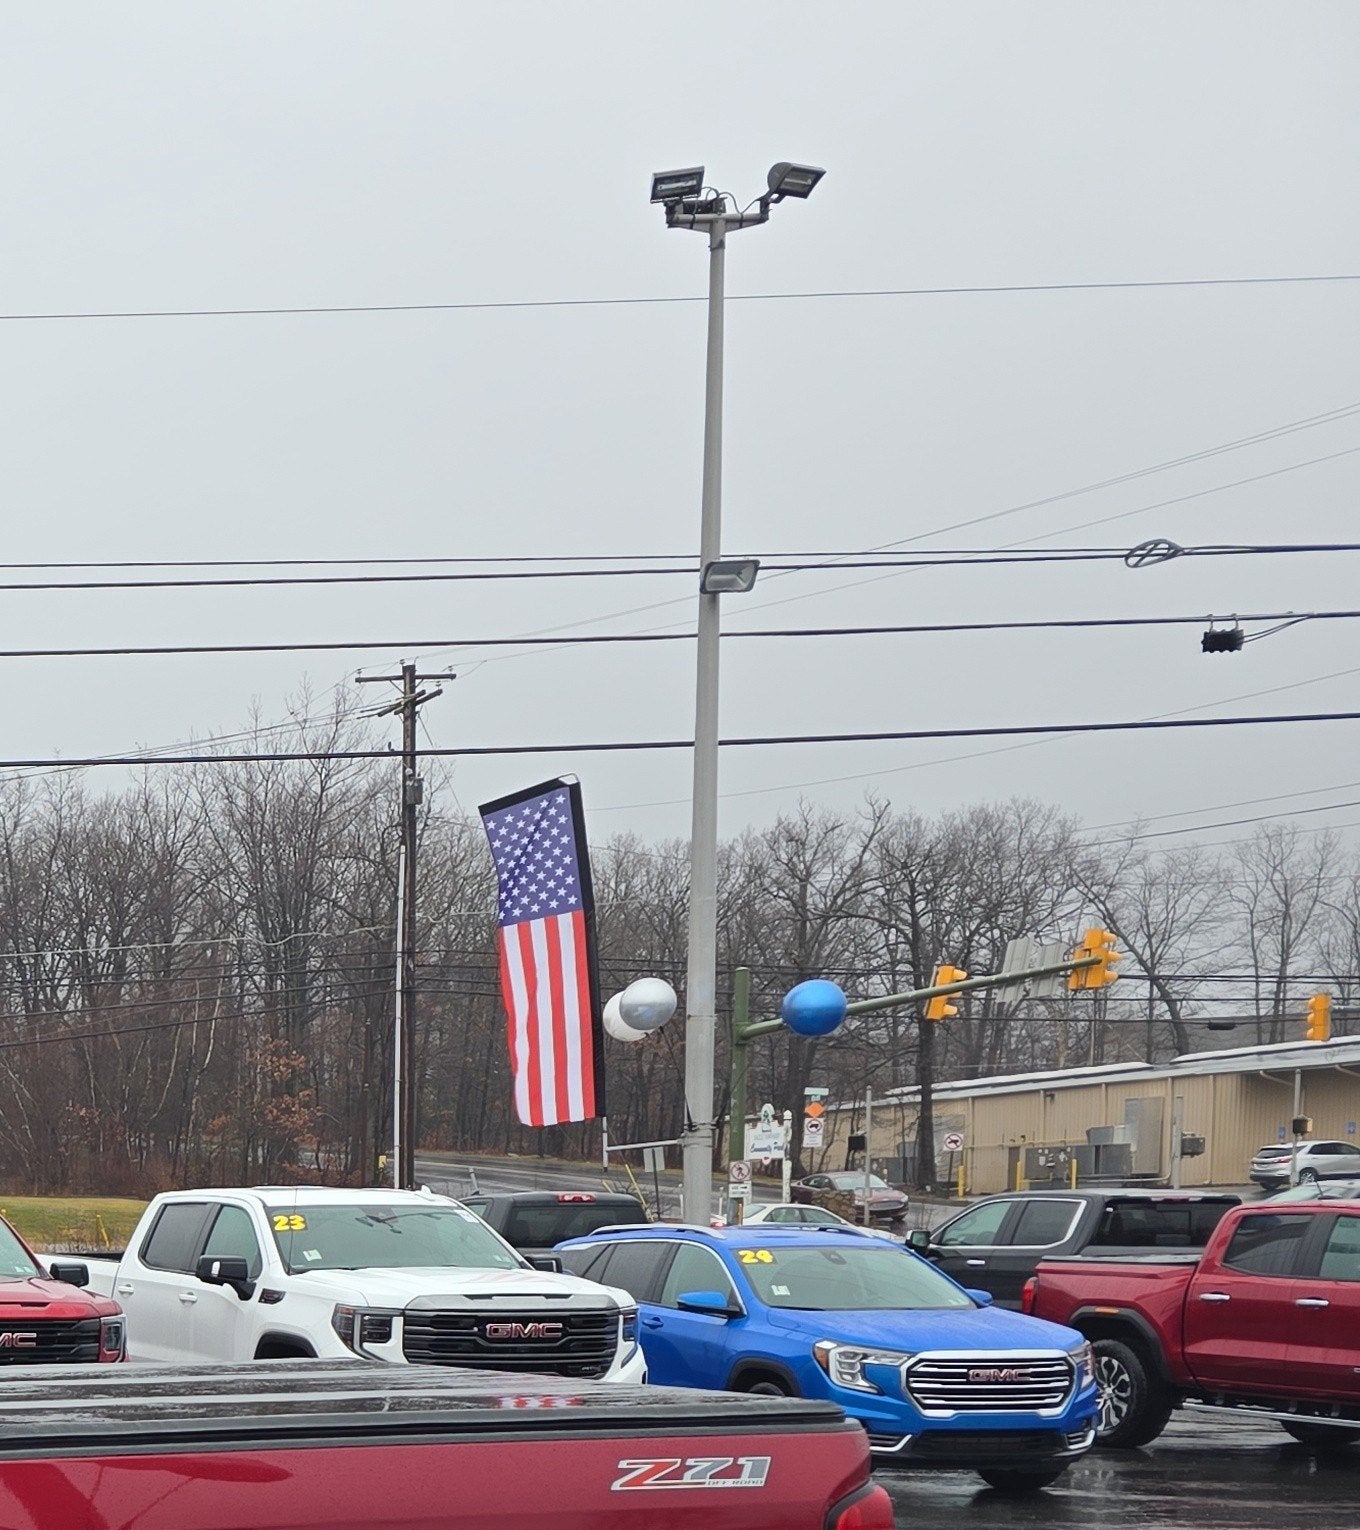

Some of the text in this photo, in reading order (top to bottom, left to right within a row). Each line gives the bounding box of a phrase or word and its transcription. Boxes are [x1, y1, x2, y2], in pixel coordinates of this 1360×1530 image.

[273, 1214, 306, 1231] 23
[486, 1322, 563, 1338] GMC
[968, 1368, 1032, 1382] GMC
[611, 1457, 771, 1490] Z71
